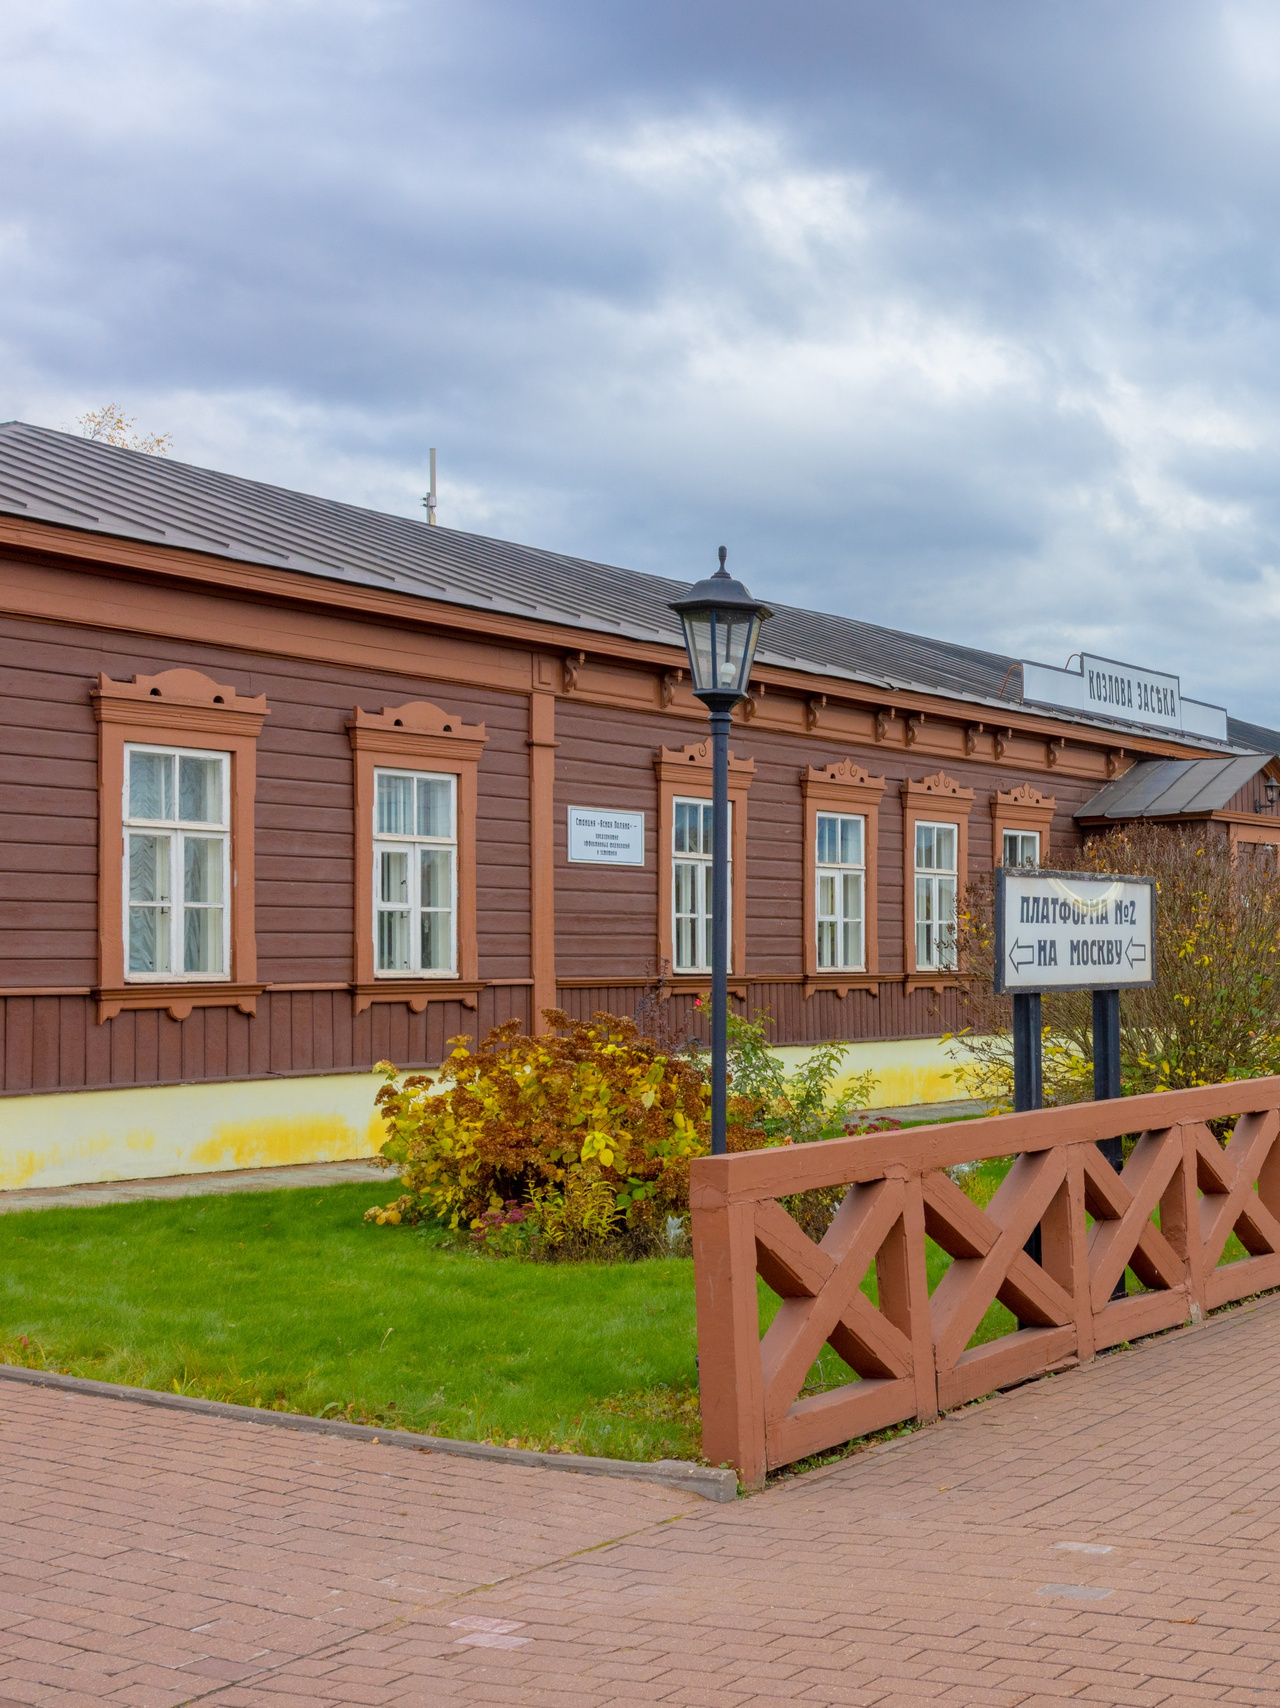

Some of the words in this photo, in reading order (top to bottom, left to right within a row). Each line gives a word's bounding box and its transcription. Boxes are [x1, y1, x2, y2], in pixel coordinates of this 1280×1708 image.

[1088, 669, 1133, 708] КОЗЛОВА
[1137, 681, 1176, 717] ЗАСѢКА
[1020, 896, 1109, 925] ПЛАТФОРМА
[1114, 900, 1137, 925] №2
[1037, 939, 1058, 967] НА
[1069, 939, 1123, 967] МОСКВУ
